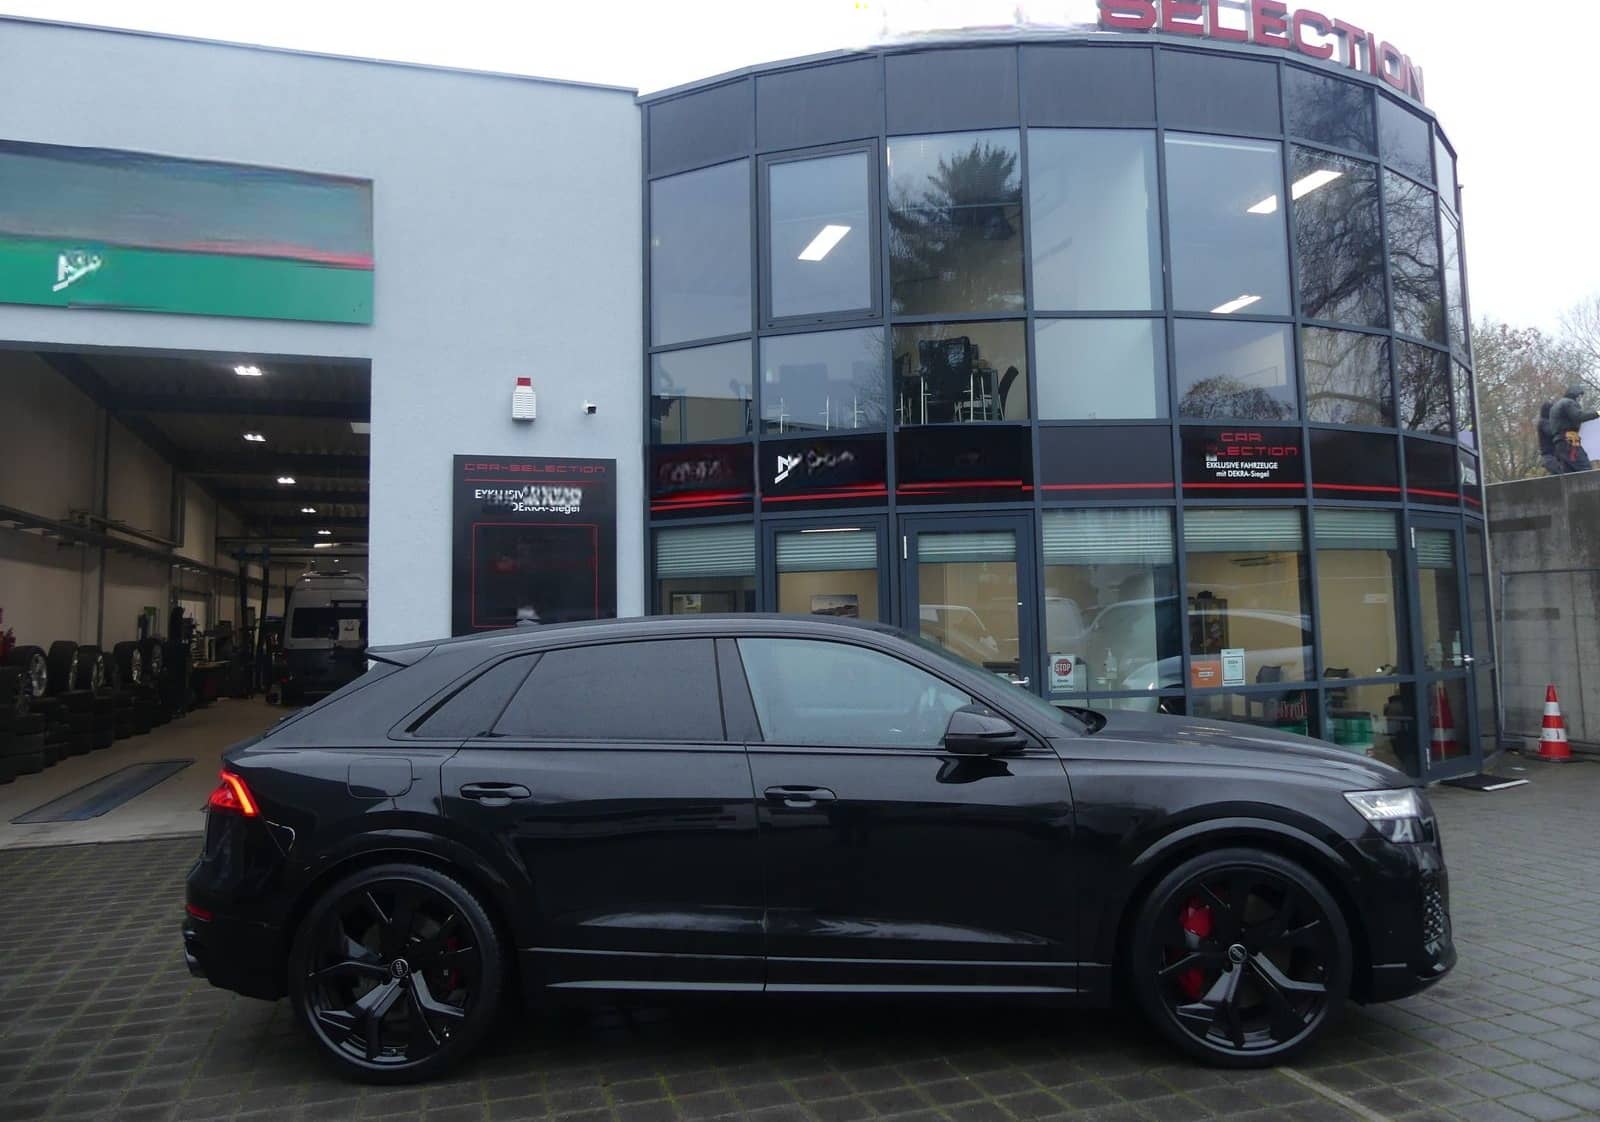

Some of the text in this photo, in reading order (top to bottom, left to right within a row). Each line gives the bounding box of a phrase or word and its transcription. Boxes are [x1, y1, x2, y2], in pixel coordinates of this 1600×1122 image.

[1099, 0, 1425, 107] SELECTION
[1221, 433, 1262, 442] CAR
[1055, 663, 1071, 673] STOP
